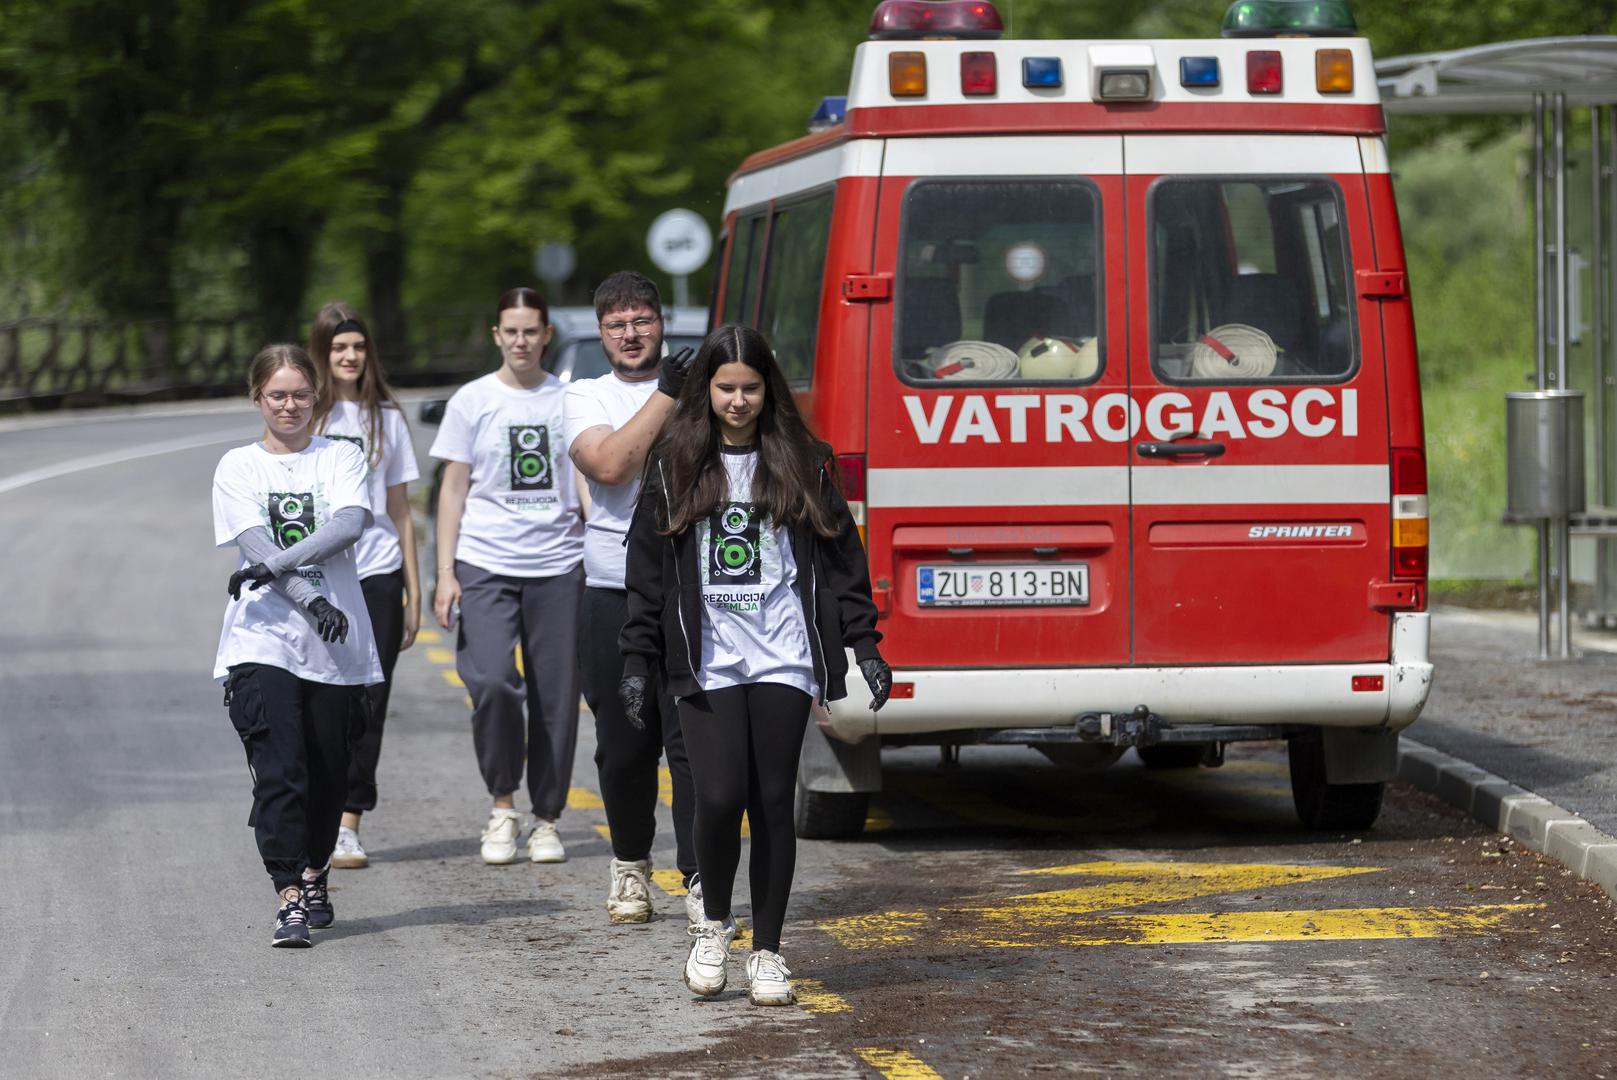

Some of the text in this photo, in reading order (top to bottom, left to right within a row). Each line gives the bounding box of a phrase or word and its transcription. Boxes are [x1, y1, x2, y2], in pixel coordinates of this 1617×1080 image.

[902, 388, 1359, 444] VATROGASCI
[1247, 525, 1353, 538] SPRINTER
[938, 571, 1082, 597] ZU 813-BN
[703, 592, 766, 603] REZOLUCIJA
